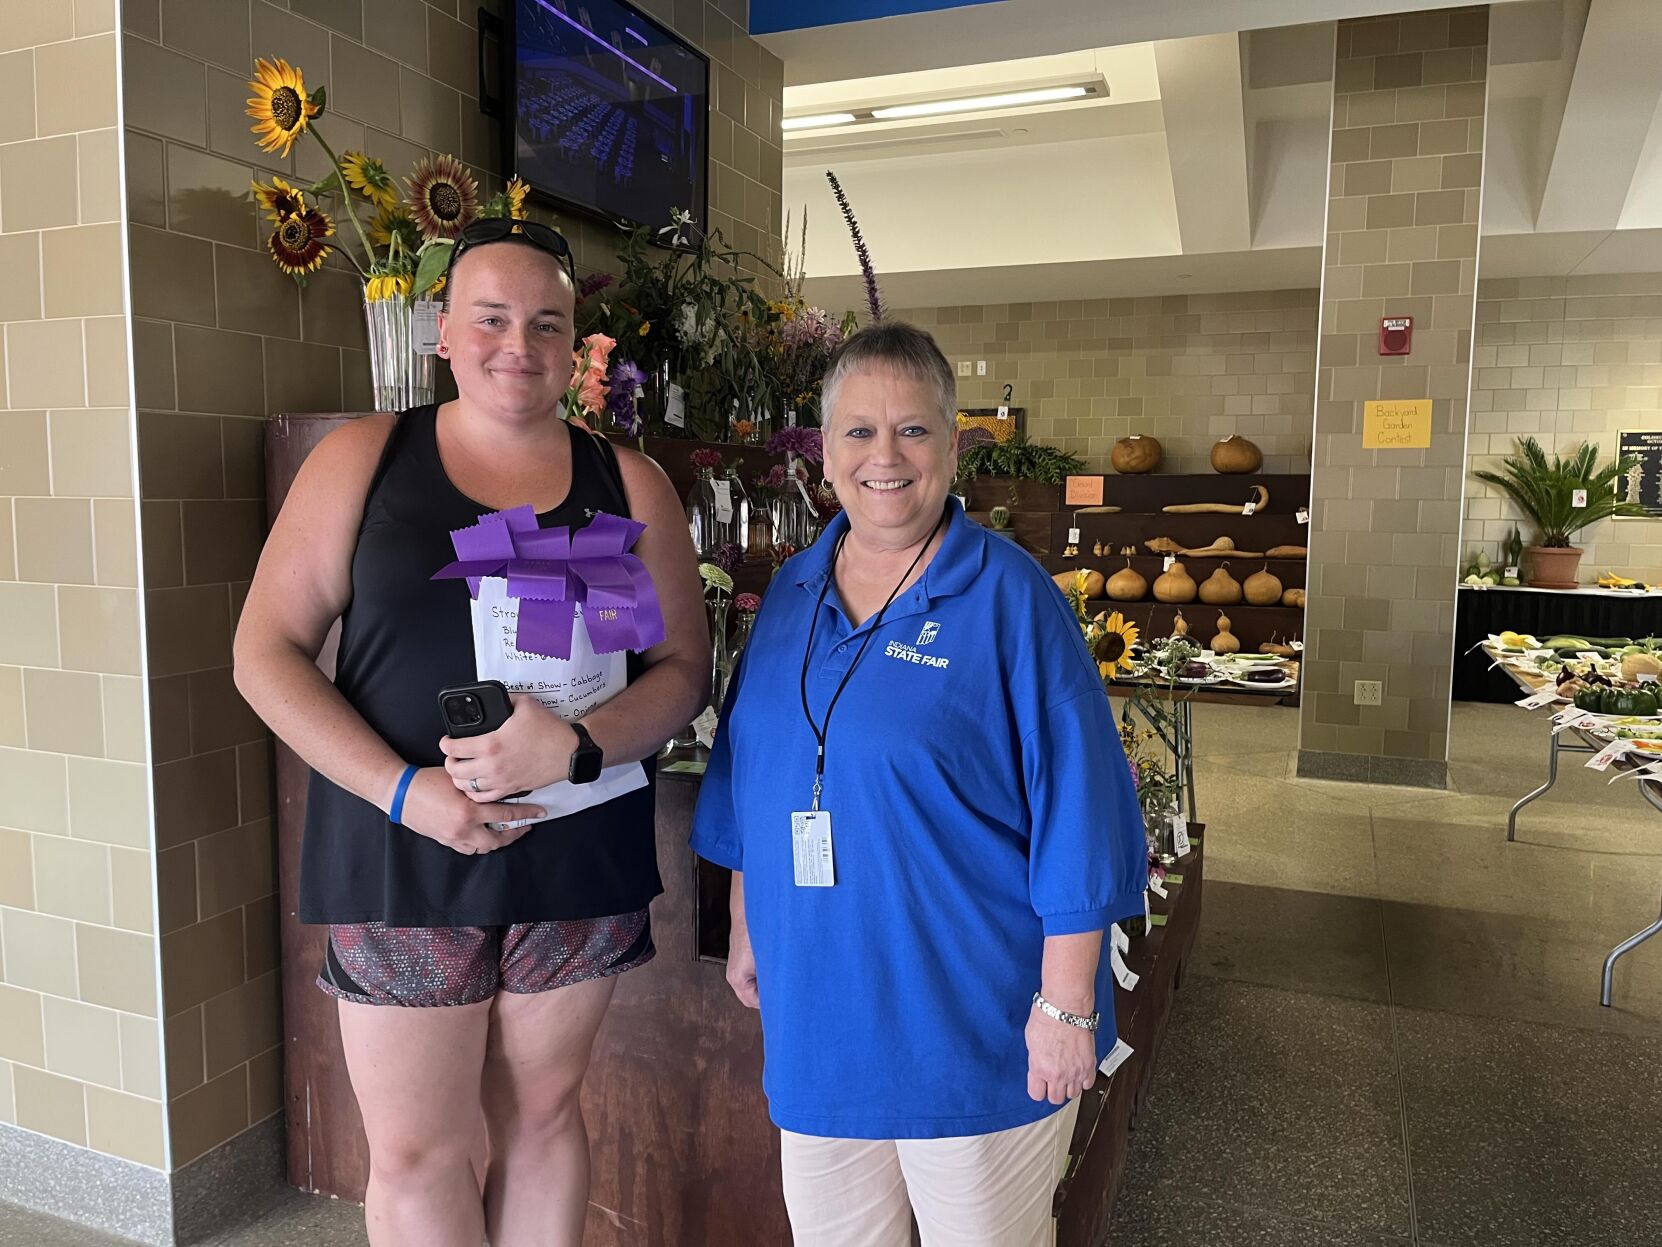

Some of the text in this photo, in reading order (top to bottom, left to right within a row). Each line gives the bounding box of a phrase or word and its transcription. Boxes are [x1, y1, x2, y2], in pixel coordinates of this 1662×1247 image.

[1376, 405, 1417, 419] Backyard
[1383, 418, 1412, 429] Garden
[1378, 432, 1411, 443] Contest
[600, 609, 617, 621] FAIR
[889, 641, 916, 652] INDIANA
[885, 646, 949, 668] STATE FAIR
[503, 681, 524, 690] Best
[570, 671, 603, 687] Cabbage
[568, 682, 606, 703] Cucumbers
